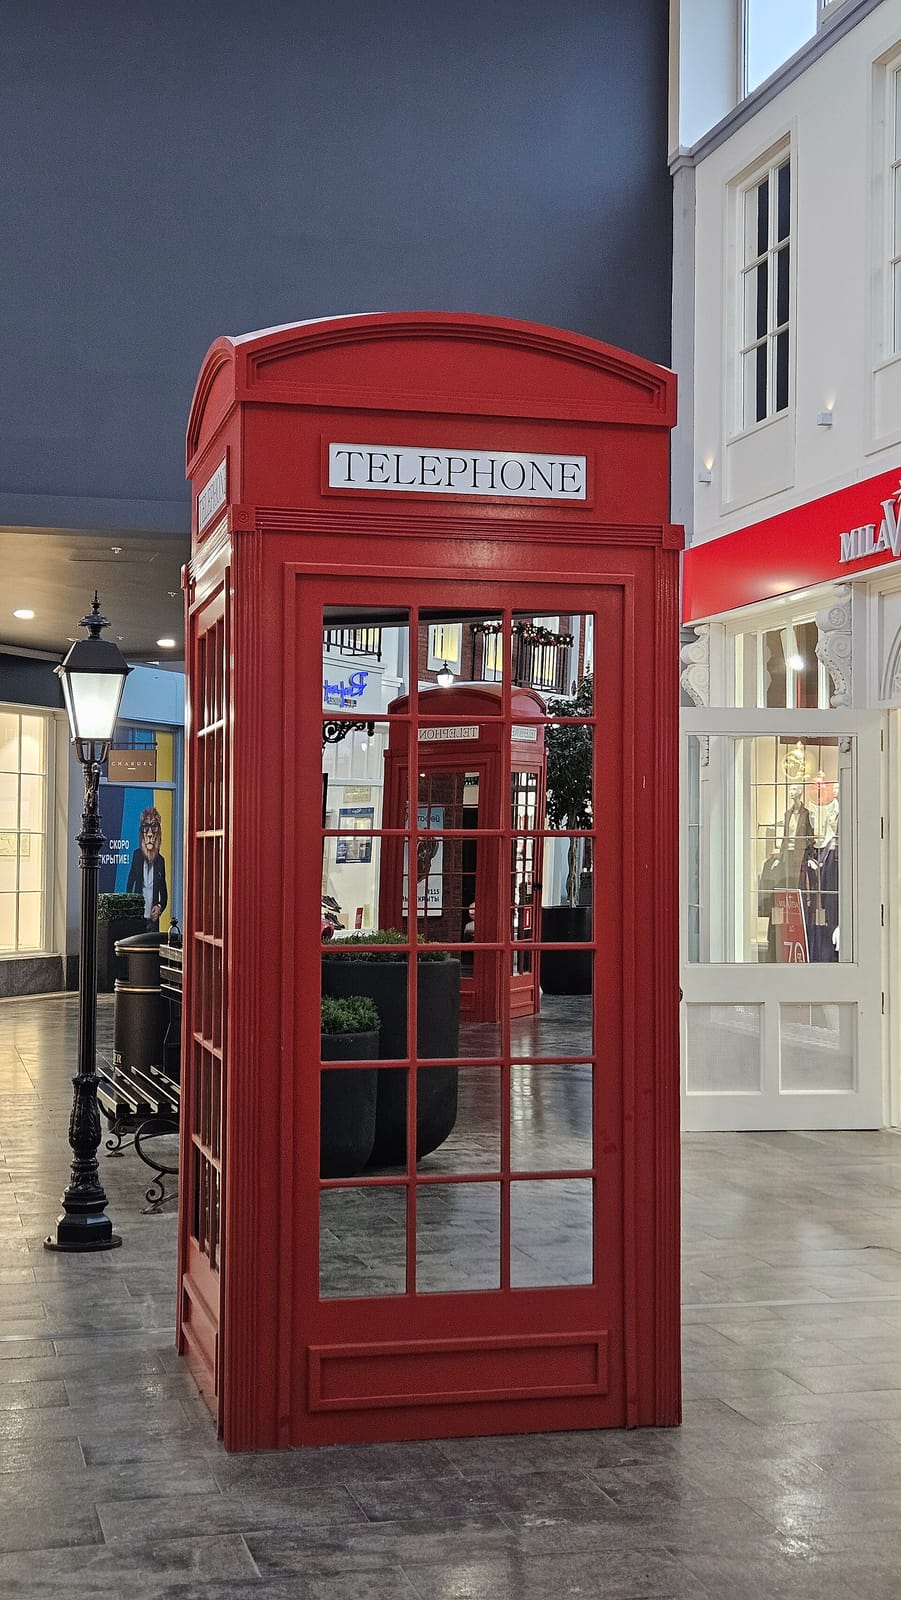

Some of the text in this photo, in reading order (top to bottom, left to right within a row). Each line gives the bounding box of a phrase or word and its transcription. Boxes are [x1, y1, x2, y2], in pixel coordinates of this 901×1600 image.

[335, 450, 583, 494] TELEPHONE
[109, 839, 130, 850] СКОРО
[98, 854, 130, 865] ТКРЫТИЕ!
